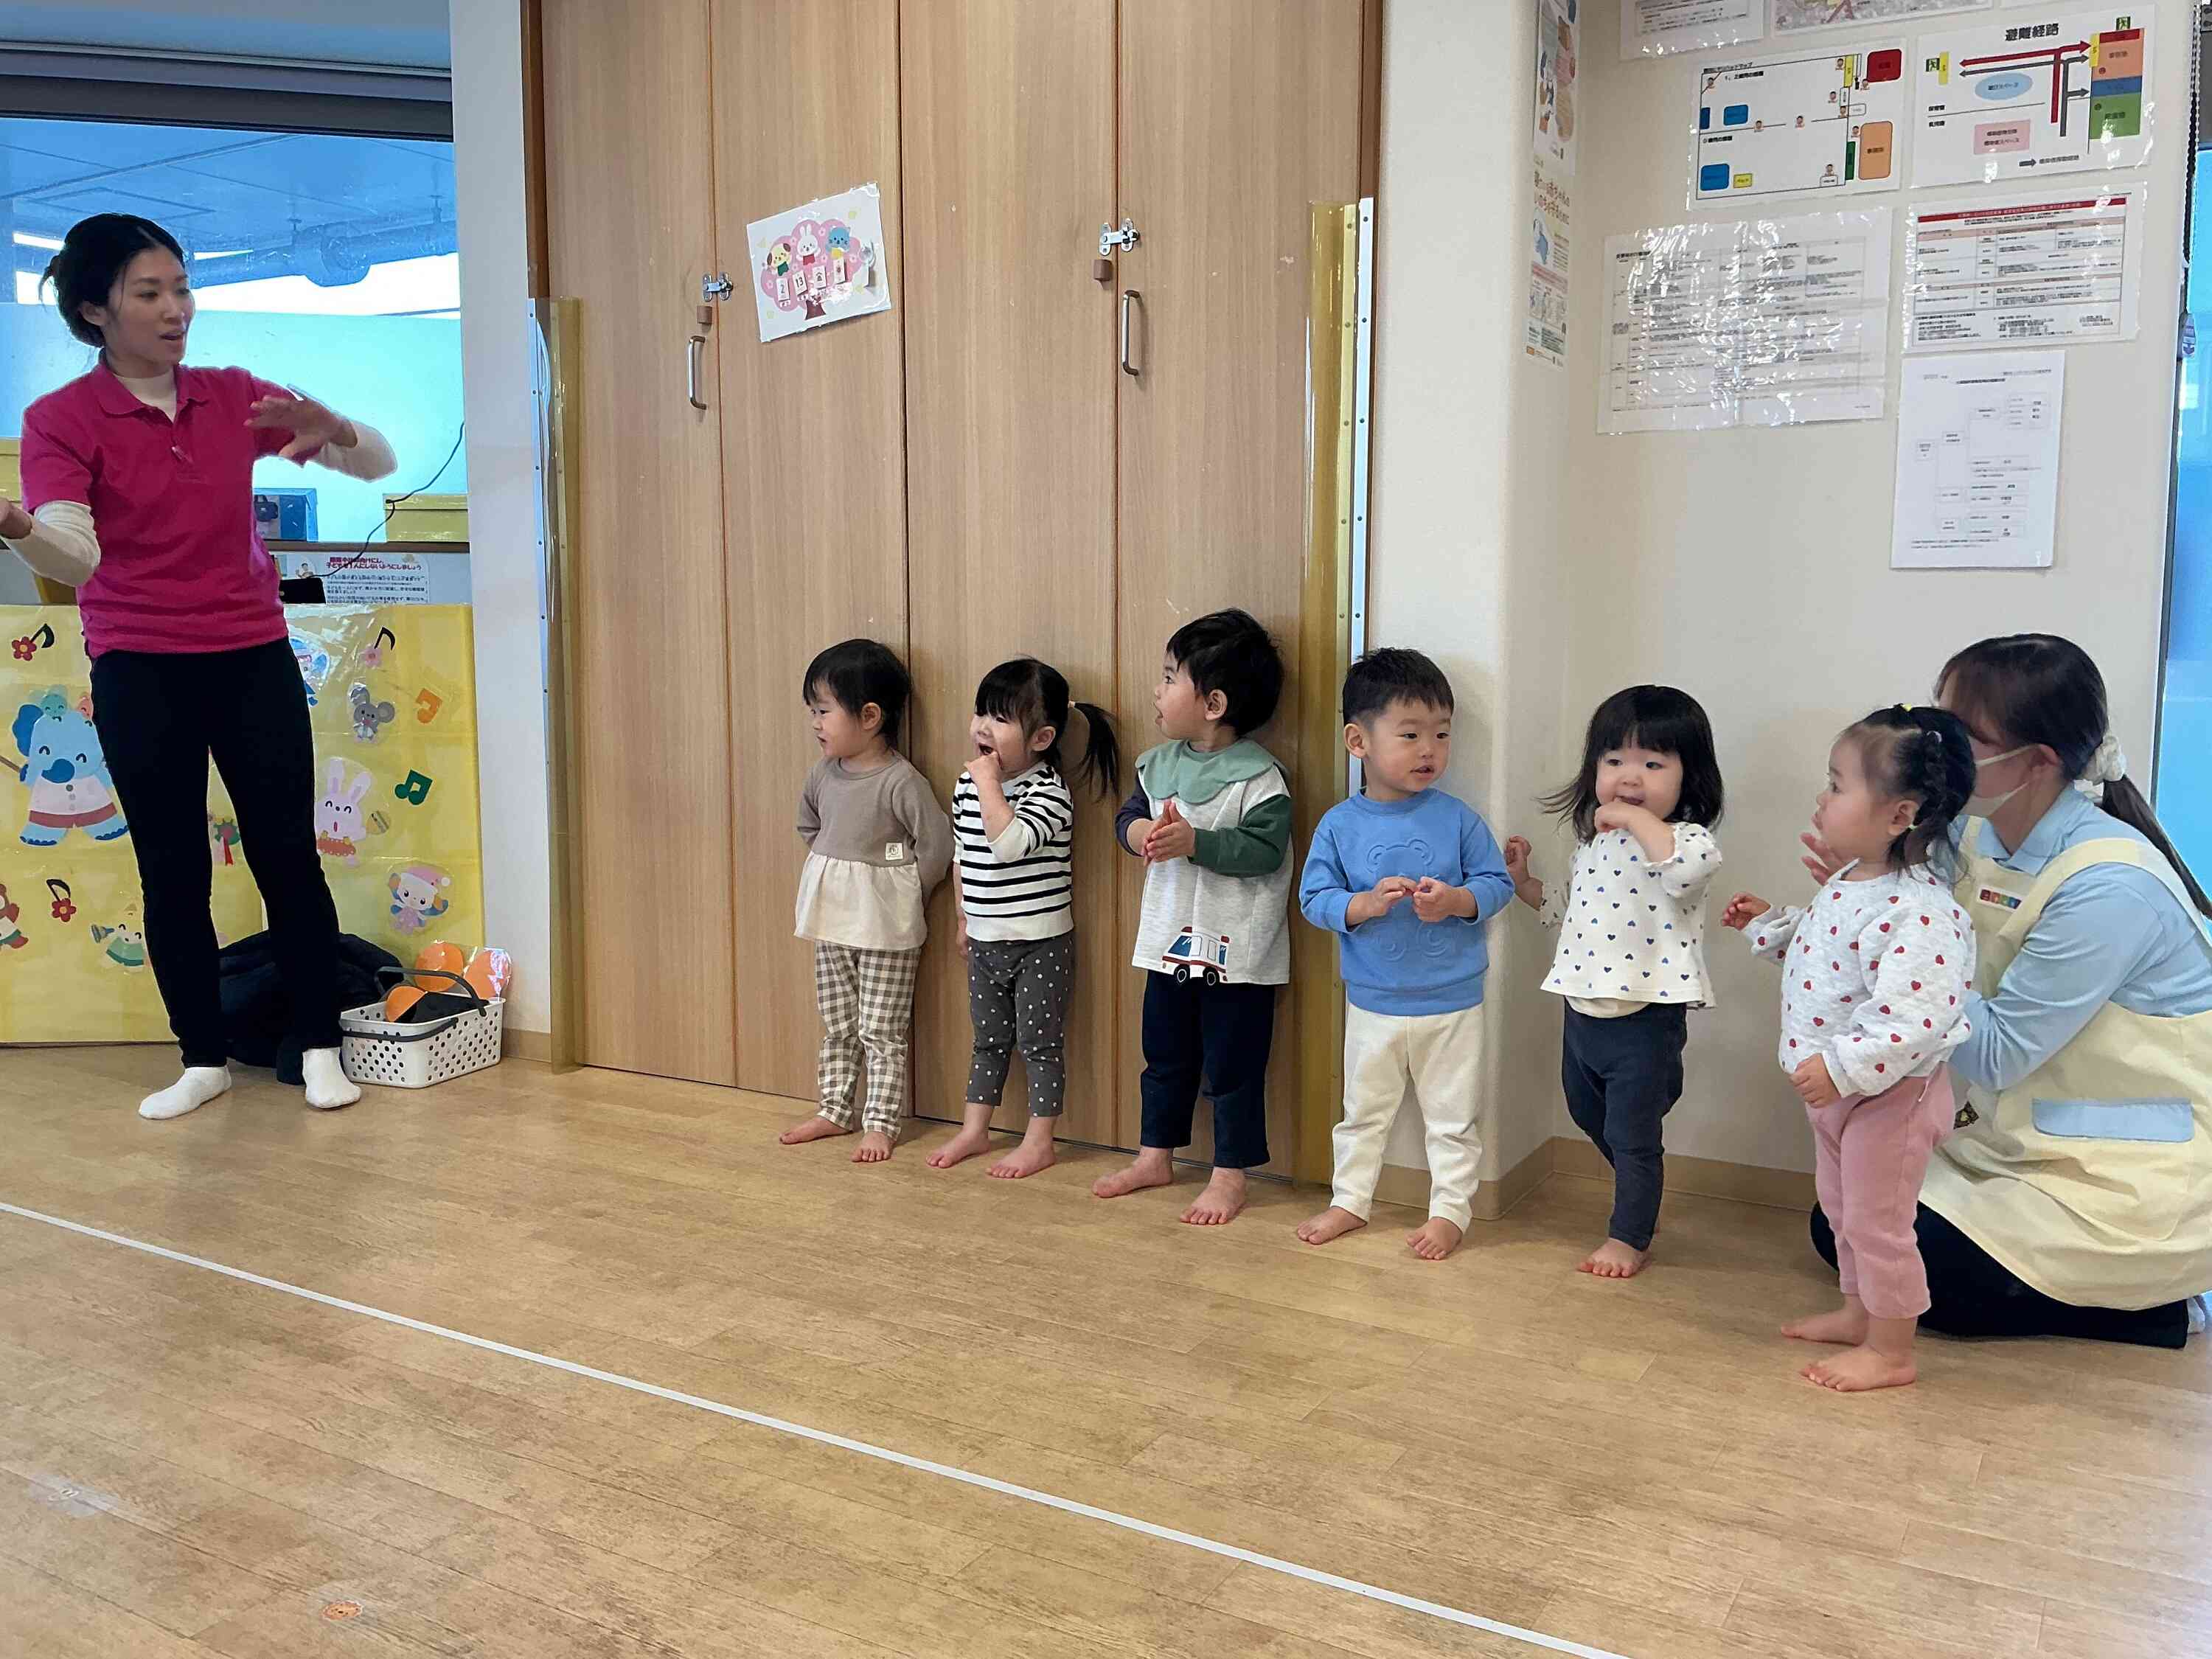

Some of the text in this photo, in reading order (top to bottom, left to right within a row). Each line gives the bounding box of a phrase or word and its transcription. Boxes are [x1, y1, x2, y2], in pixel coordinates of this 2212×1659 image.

[2005, 23, 2059, 41] 避難経路
[780, 284, 785, 294] 2
[796, 276, 804, 288] 13
